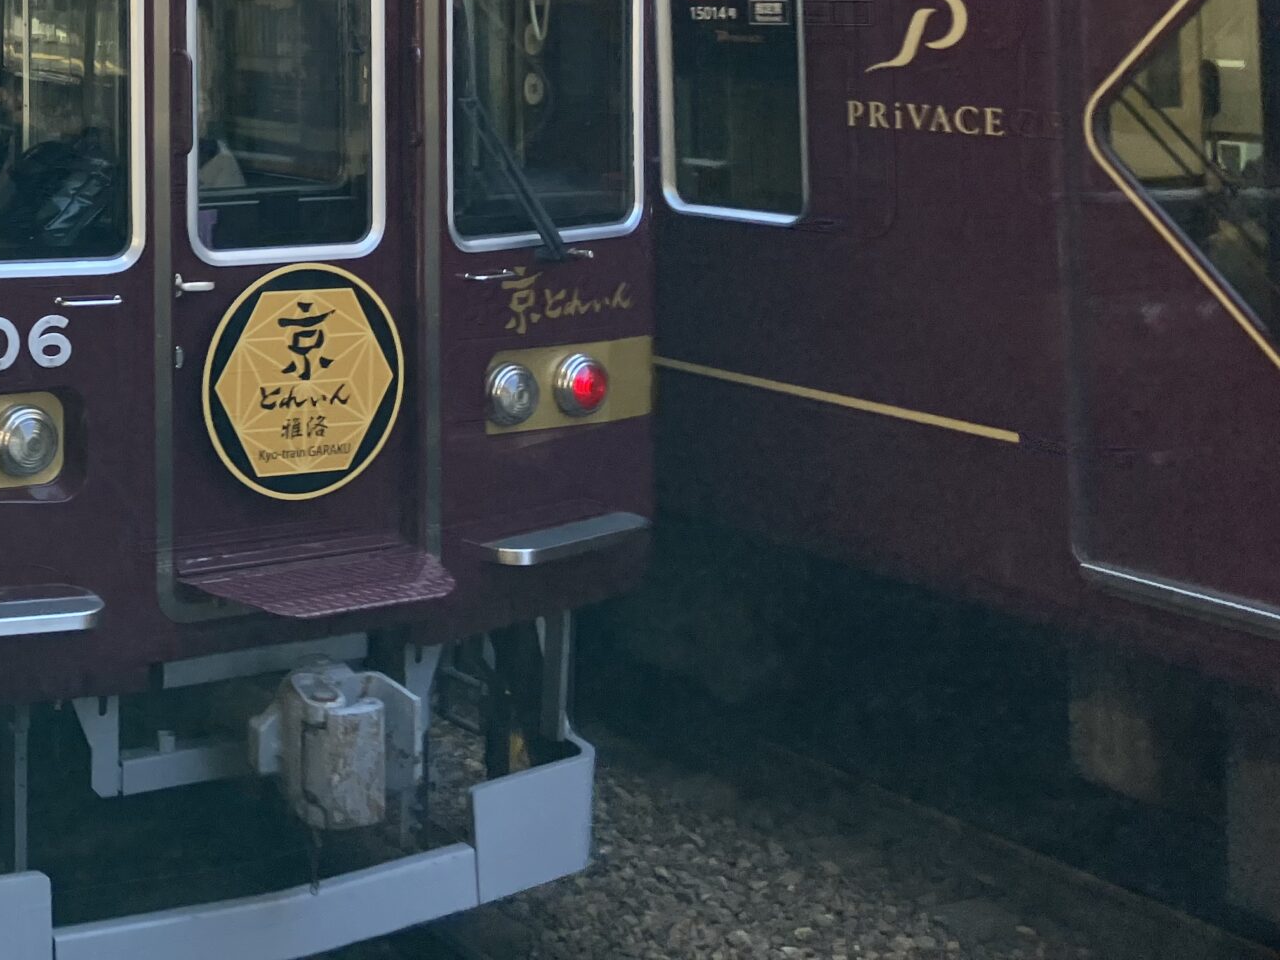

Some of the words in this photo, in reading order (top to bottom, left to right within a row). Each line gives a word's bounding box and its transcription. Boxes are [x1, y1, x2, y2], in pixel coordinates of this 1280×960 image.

[846, 100, 1007, 136] PRiVACE
[277, 301, 336, 381] 京
[260, 383, 350, 410] とれいん
[280, 415, 328, 439] 雅洛
[258, 448, 306, 463] Kyo-train
[308, 443, 351, 457] GARAKU
